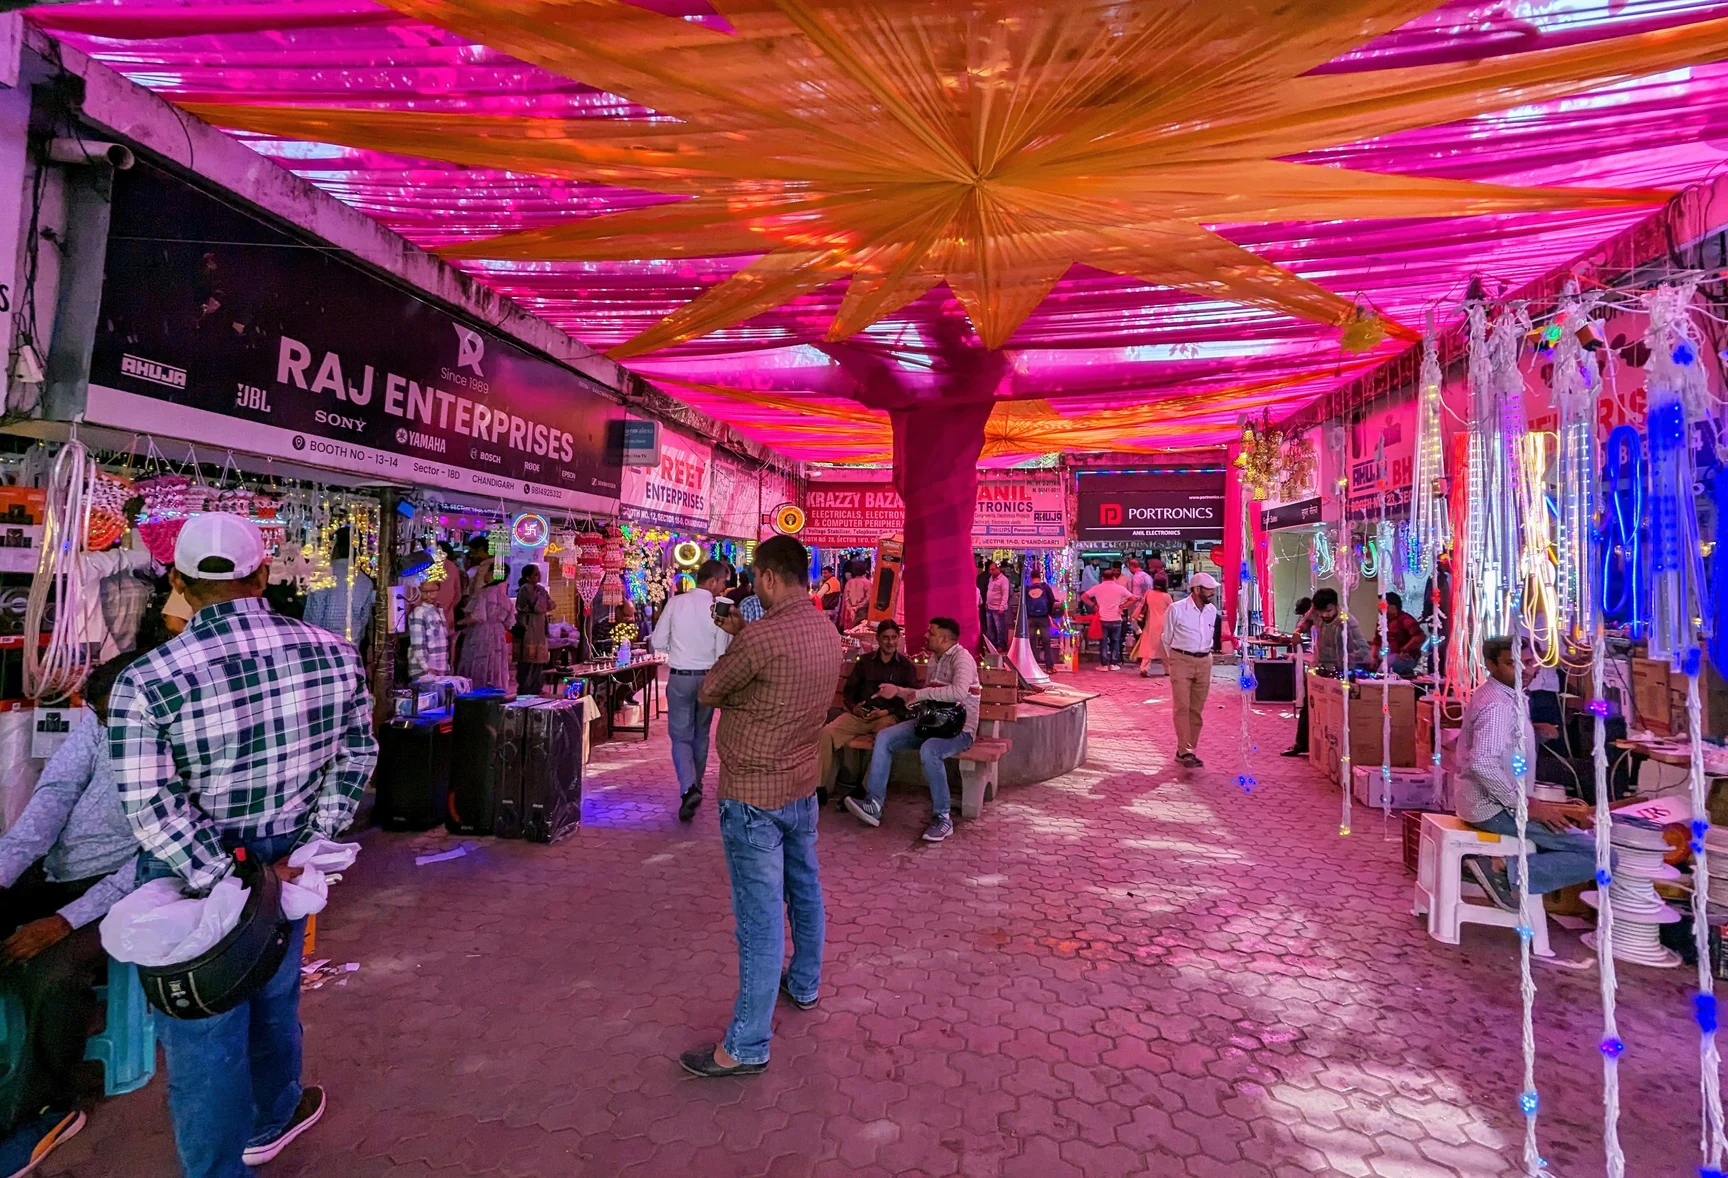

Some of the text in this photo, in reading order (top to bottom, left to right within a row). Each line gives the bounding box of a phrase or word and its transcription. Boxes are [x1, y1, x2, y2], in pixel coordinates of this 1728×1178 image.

[122, 357, 186, 386] AHUJA
[440, 366, 489, 394] Since 1989
[237, 383, 271, 412] JBL
[277, 336, 573, 463] RAJ ENTERPRISES
[315, 410, 367, 432] SONY
[409, 431, 446, 453] YAMAHA
[310, 441, 347, 457] BOOTH
[350, 451, 365, 461] NO
[375, 454, 398, 467] 13-14
[480, 452, 501, 463] BOSCH
[413, 462, 440, 476] Sector
[447, 468, 461, 480] 18D
[562, 470, 576, 480] EPSON
[646, 454, 704, 490] REET
[472, 474, 515, 490] CHANDIGARH
[646, 482, 704, 511] ENTERPRISES
[806, 492, 860, 508] KRAZZY
[977, 486, 1031, 501] ANIL
[822, 519, 862, 527] COMPUTER
[1034, 512, 1062, 522] AHUJA
[1128, 507, 1213, 520] PORTRONICS
